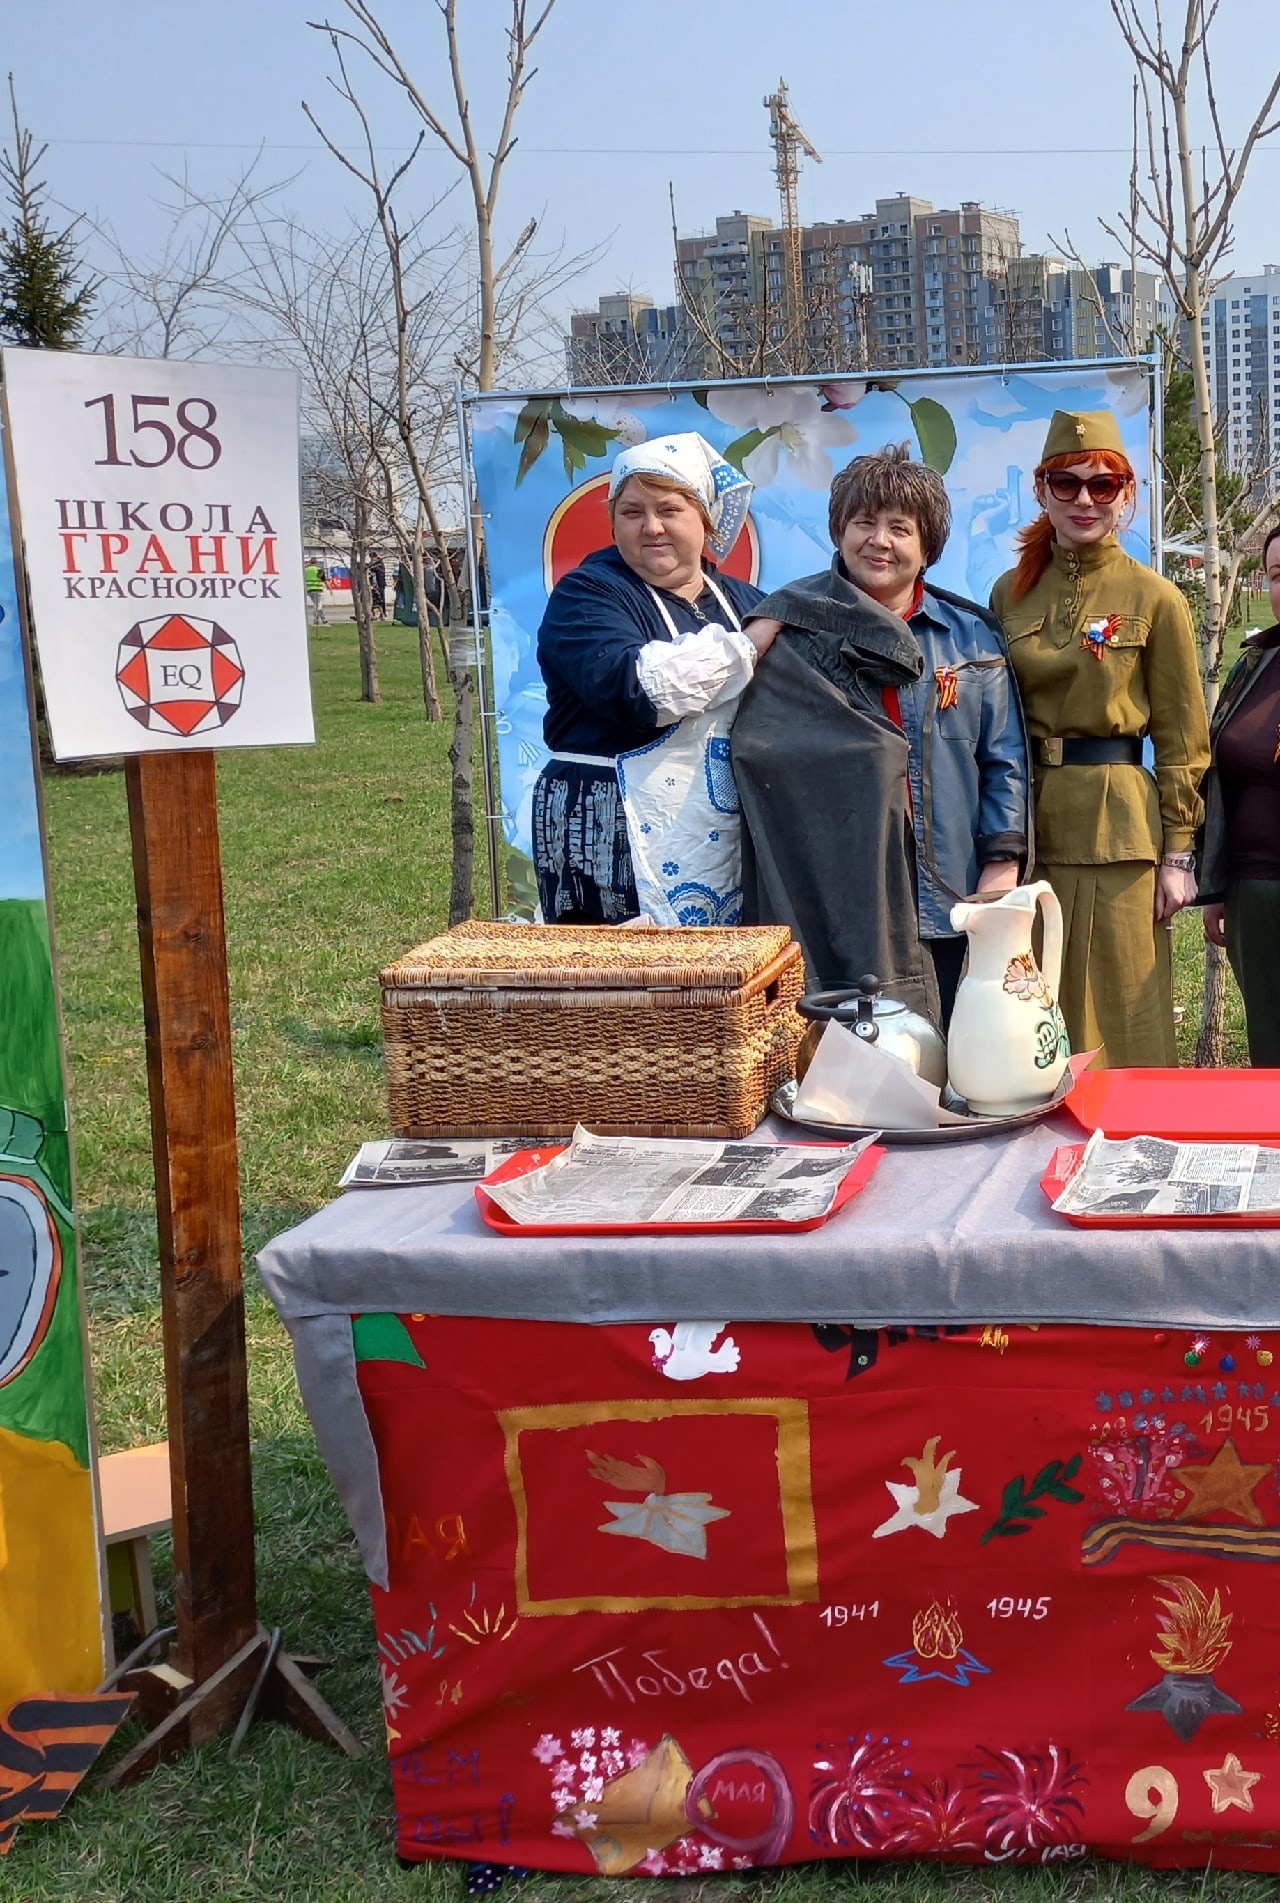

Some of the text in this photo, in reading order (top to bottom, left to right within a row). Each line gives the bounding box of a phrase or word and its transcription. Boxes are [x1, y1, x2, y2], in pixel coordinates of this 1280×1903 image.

[84, 393, 222, 470] 158
[55, 499, 277, 535] ШКОЛА
[58, 533, 280, 575] ГРАНИ
[63, 576, 282, 600] КРАСНОЯРСК
[160, 664, 203, 691] EQ
[1199, 1404, 1271, 1434] 1945
[818, 1600, 880, 1627] 1941
[985, 1595, 1053, 1621] 1945
[571, 1611, 791, 1704] Победа!
[711, 1779, 765, 1804] МАЯ
[1124, 1765, 1180, 1844] 9
